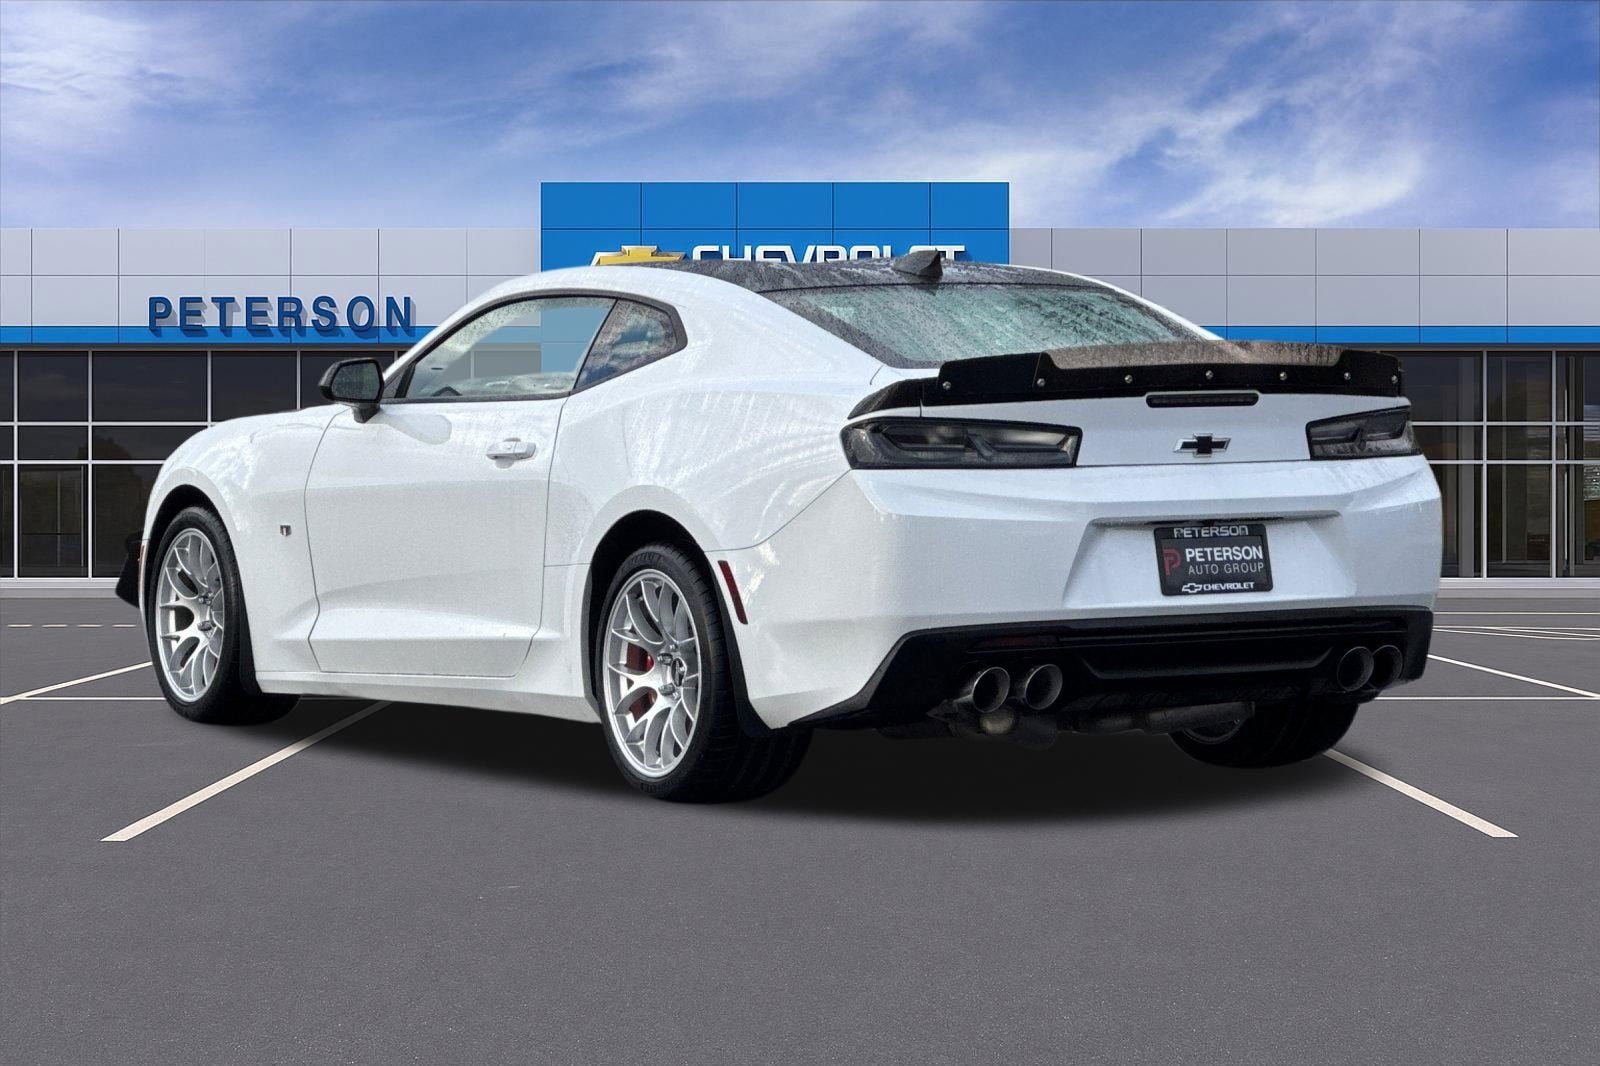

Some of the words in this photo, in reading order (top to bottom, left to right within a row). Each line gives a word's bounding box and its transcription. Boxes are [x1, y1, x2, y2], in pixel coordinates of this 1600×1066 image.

[692, 245, 965, 263] CHEVROT
[148, 295, 412, 333] PETERSON
[1173, 525, 1249, 538] PETERSON
[1185, 545, 1264, 562] PETERSON
[1188, 563, 1219, 575] AUTO
[1224, 562, 1264, 574] GROUP
[1203, 582, 1255, 591] CHEVROLET
